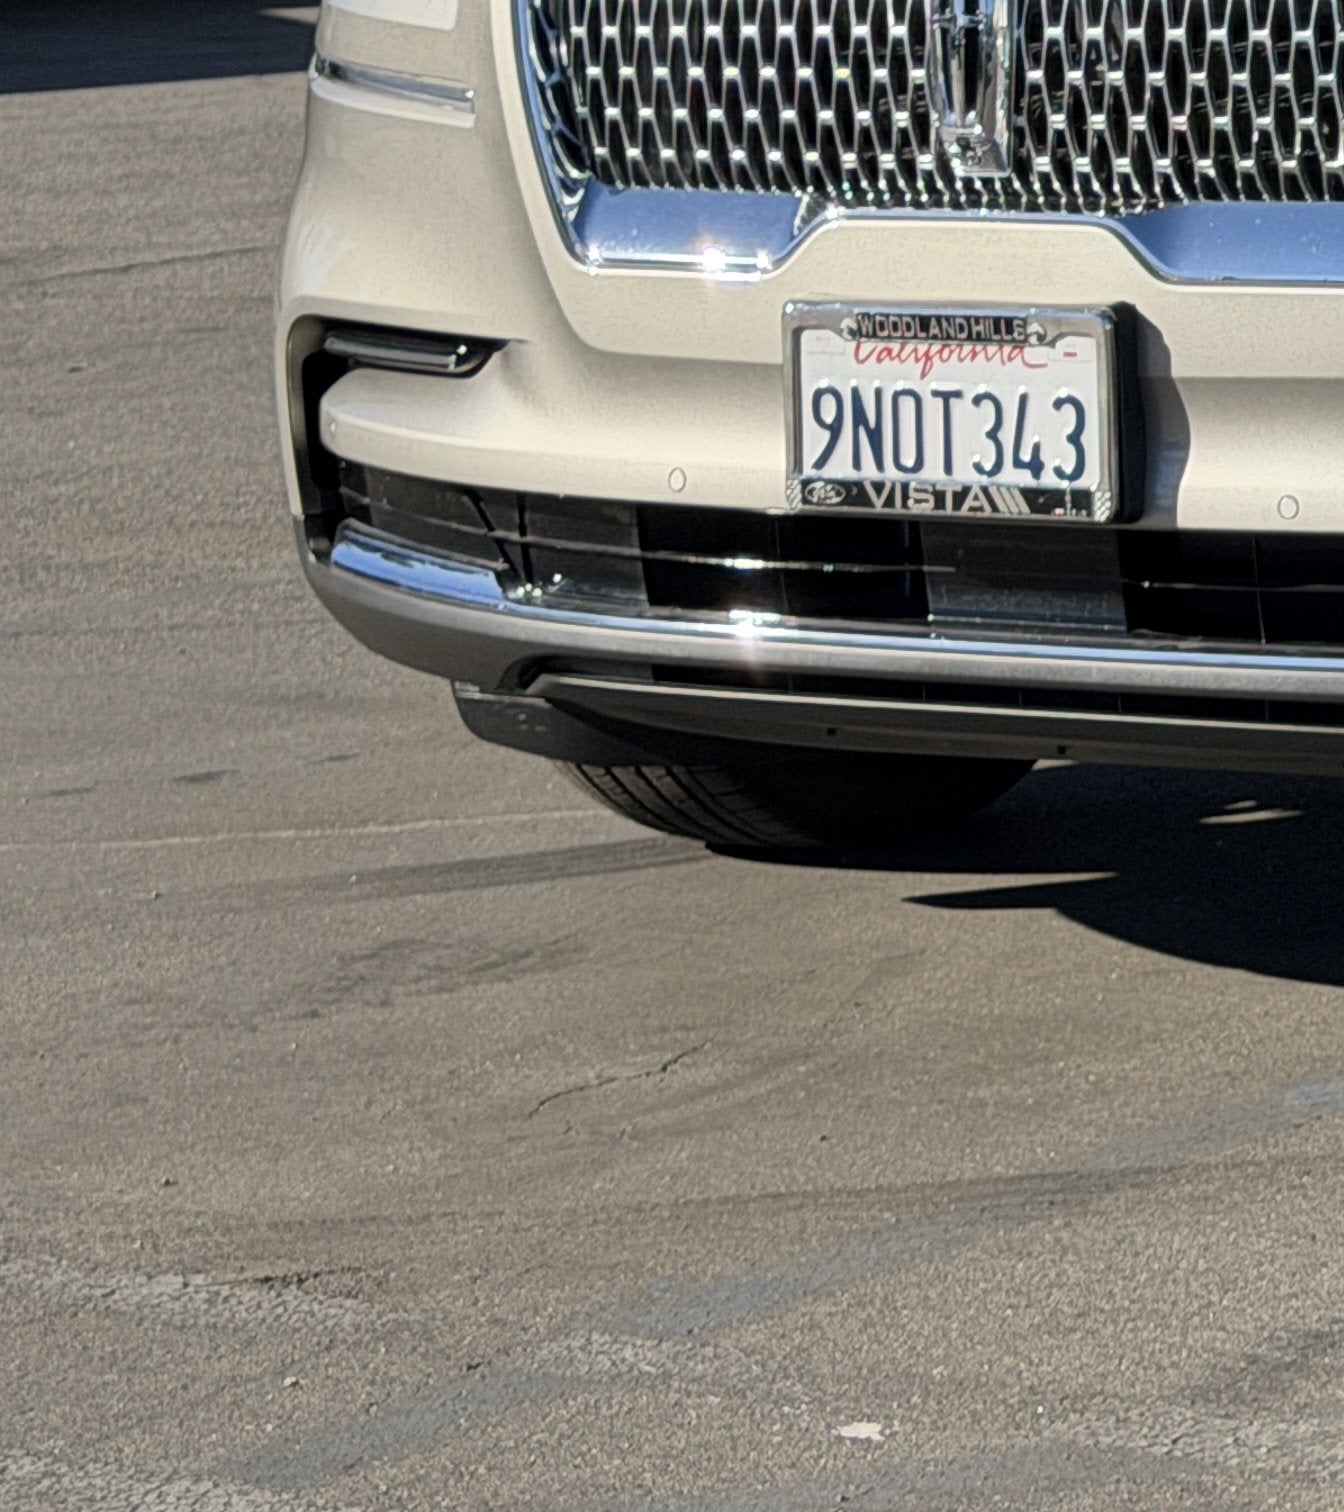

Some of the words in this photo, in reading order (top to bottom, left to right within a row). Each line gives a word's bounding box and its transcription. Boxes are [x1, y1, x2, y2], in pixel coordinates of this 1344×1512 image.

[858, 314, 969, 338] WOODLAND
[970, 317, 1026, 339] HILLS
[811, 384, 1086, 483] 9NOT343
[863, 479, 993, 515] VISTA
